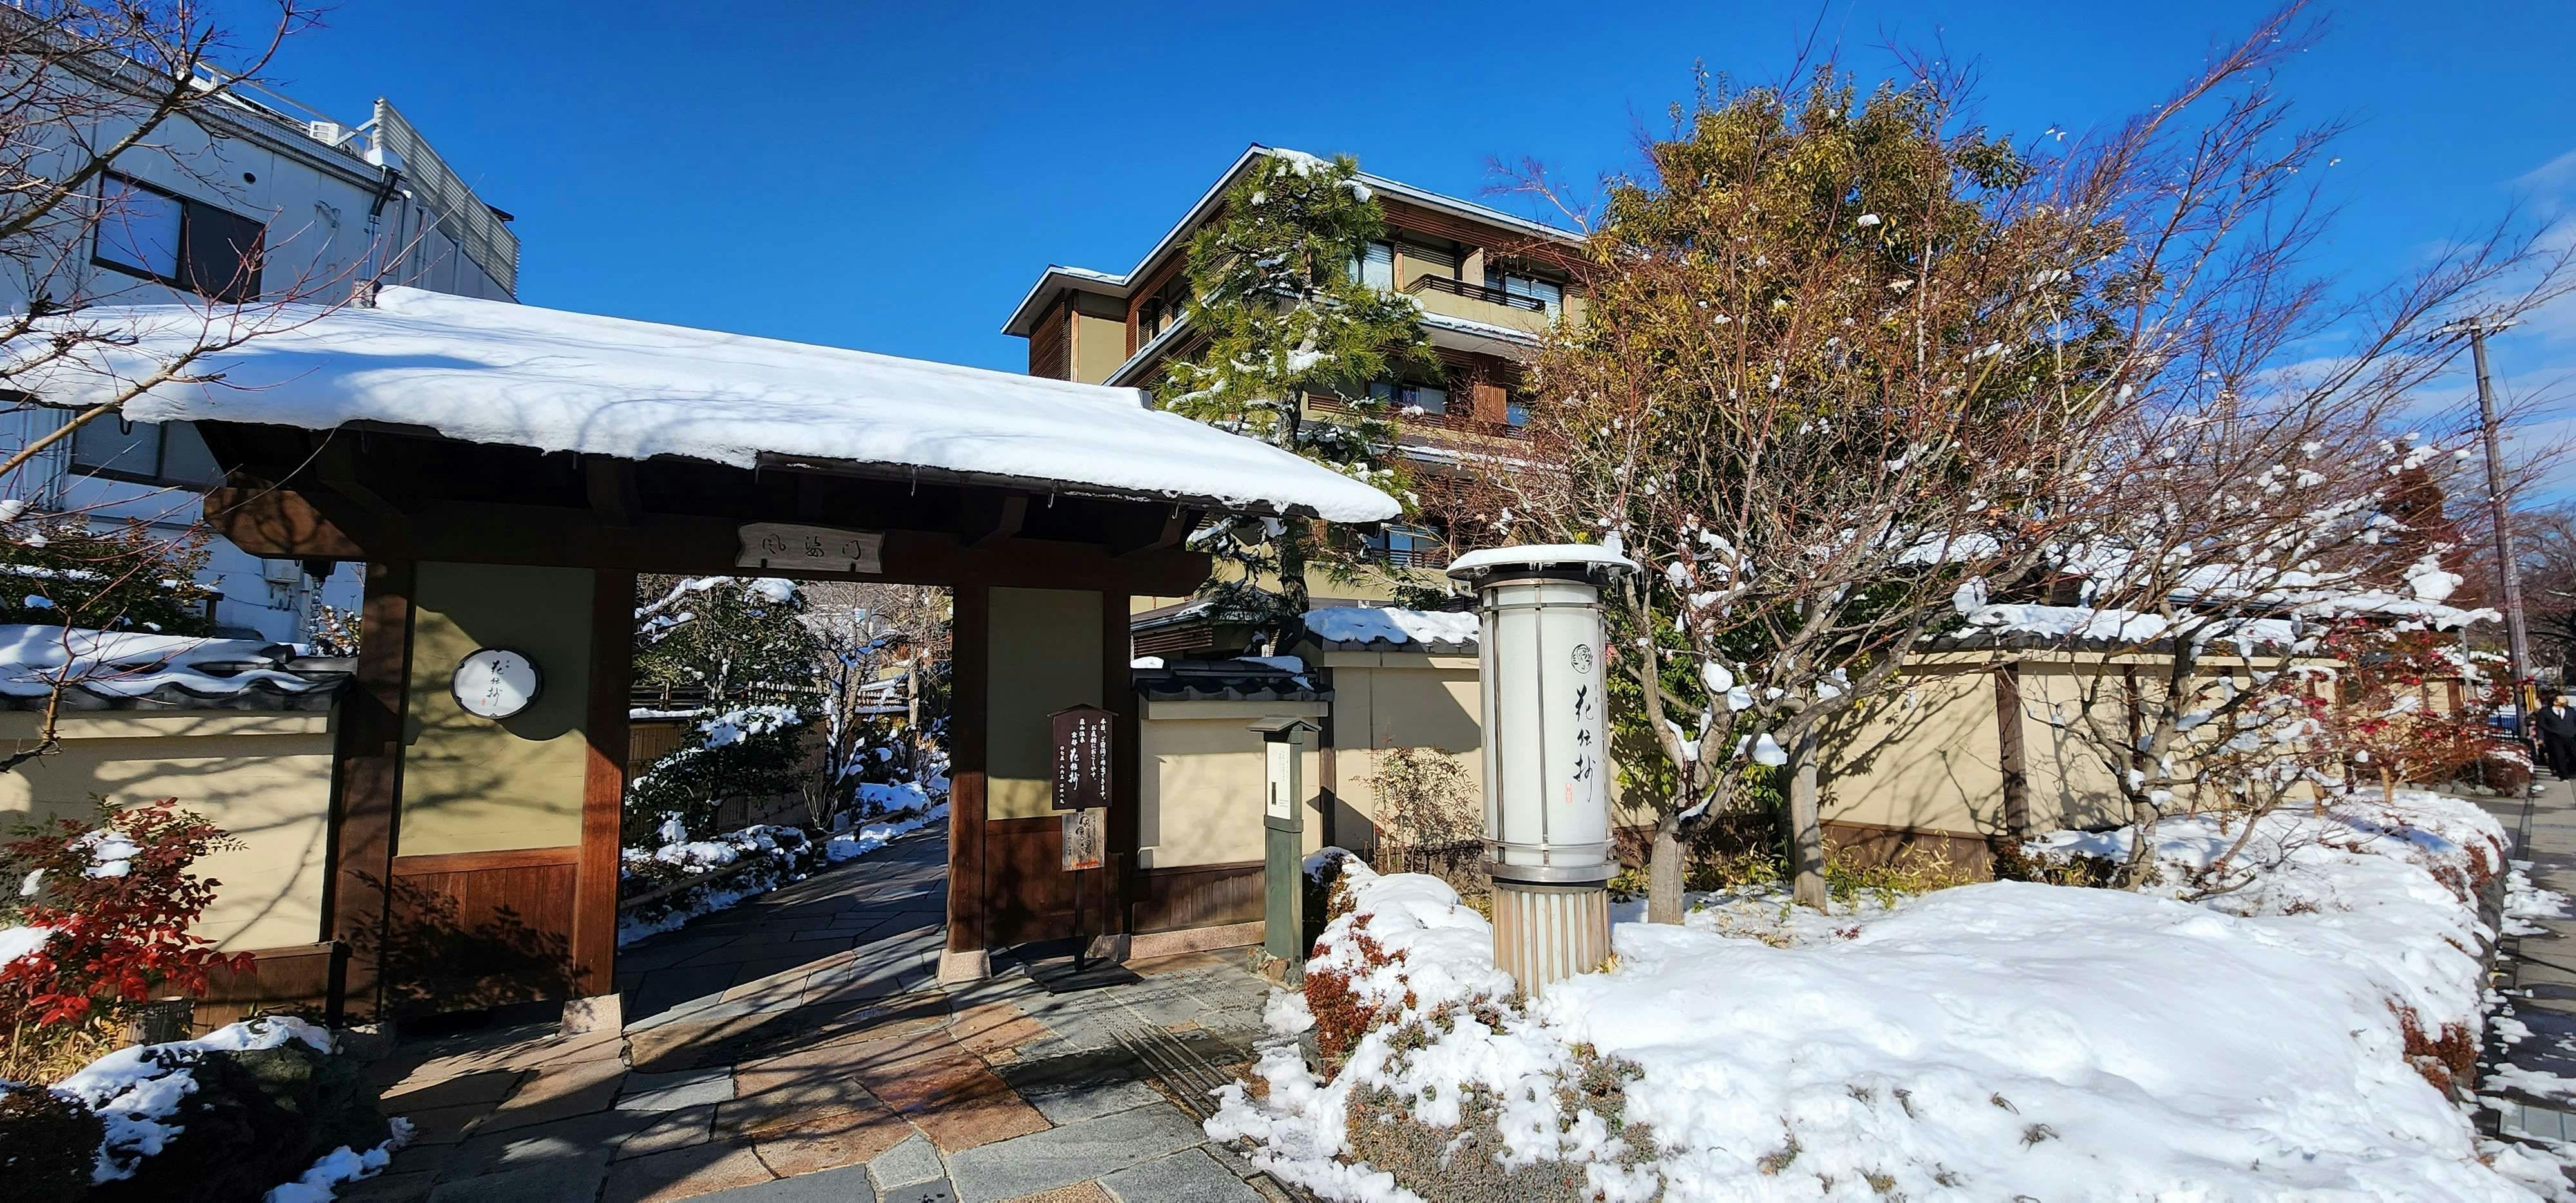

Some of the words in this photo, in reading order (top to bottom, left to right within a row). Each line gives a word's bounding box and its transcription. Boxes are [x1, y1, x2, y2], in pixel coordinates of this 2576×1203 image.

[1068, 747, 1080, 791] 花伝抄
[1573, 683, 1596, 802] 花伝抄
